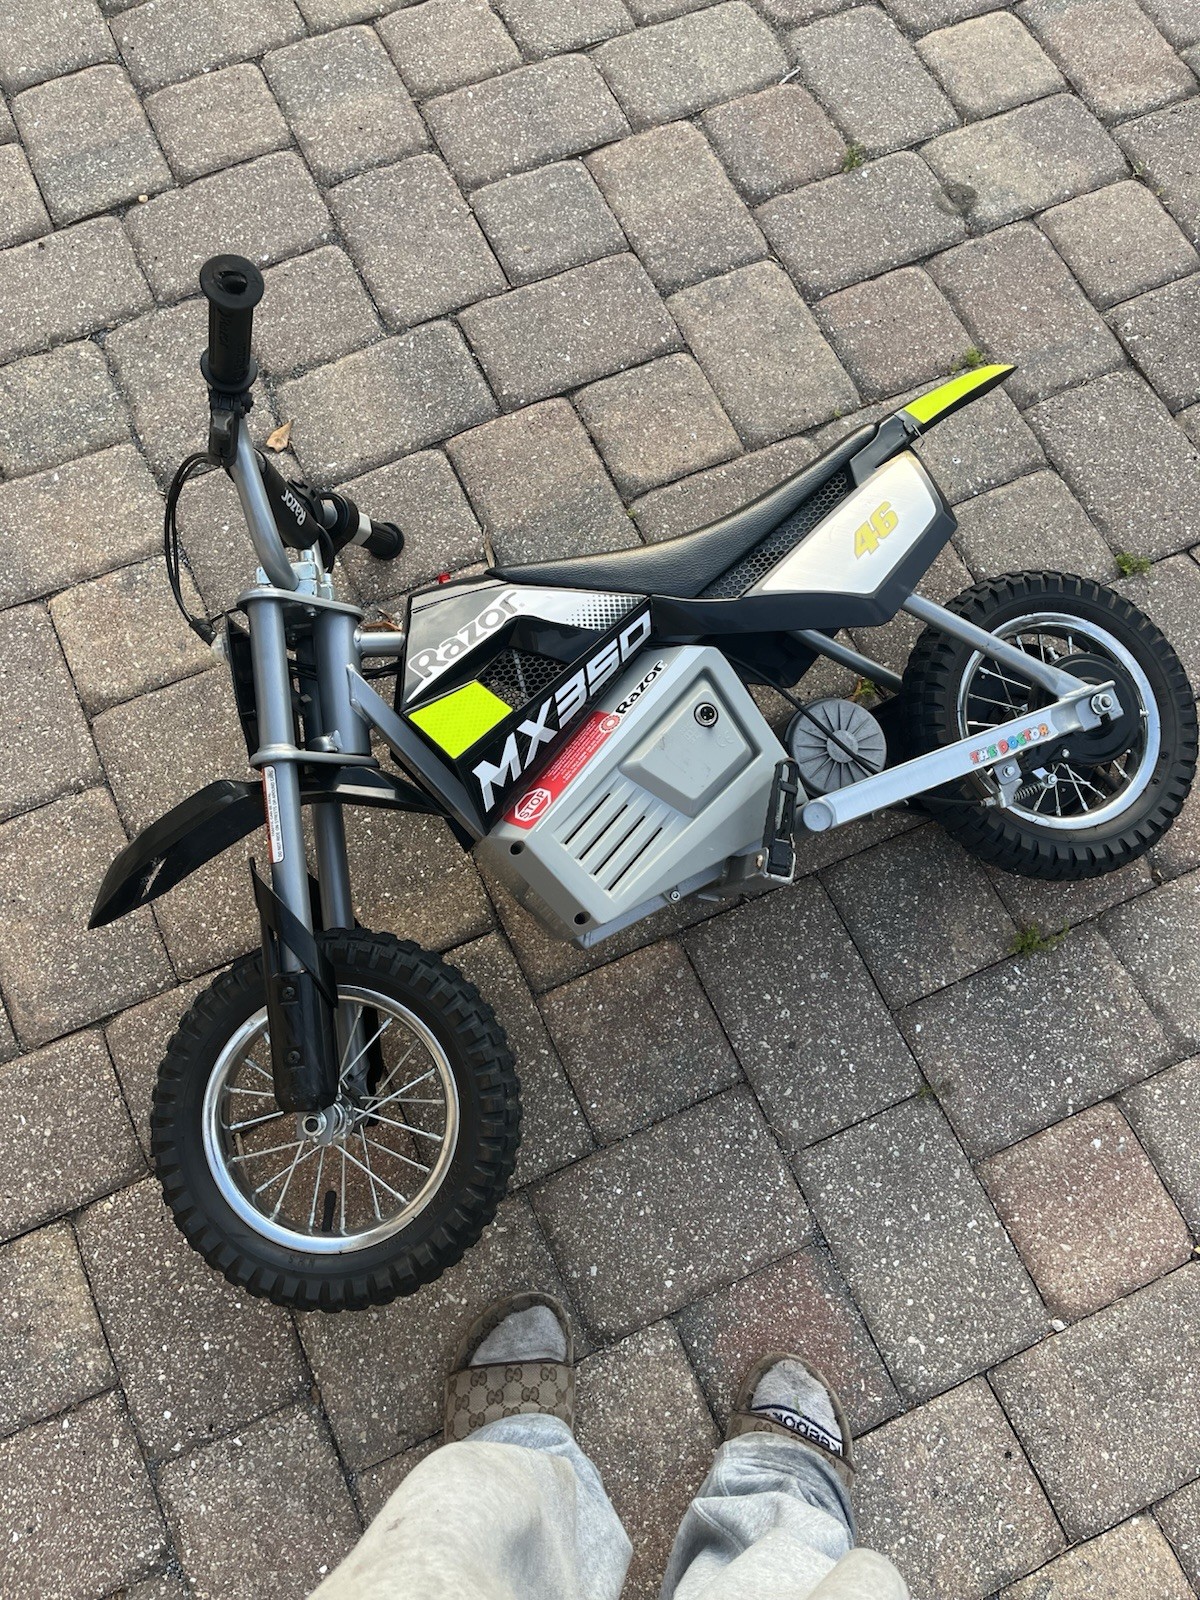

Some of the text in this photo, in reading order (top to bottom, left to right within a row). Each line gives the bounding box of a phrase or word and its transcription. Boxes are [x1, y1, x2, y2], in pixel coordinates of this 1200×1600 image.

[281, 490, 307, 526] Razor
[854, 501, 899, 560] 46
[409, 591, 517, 681] Razor
[472, 610, 652, 813] MX350
[615, 660, 665, 715] Razor
[969, 723, 1049, 765] THE DOCTOR
[518, 789, 546, 820] STOP
